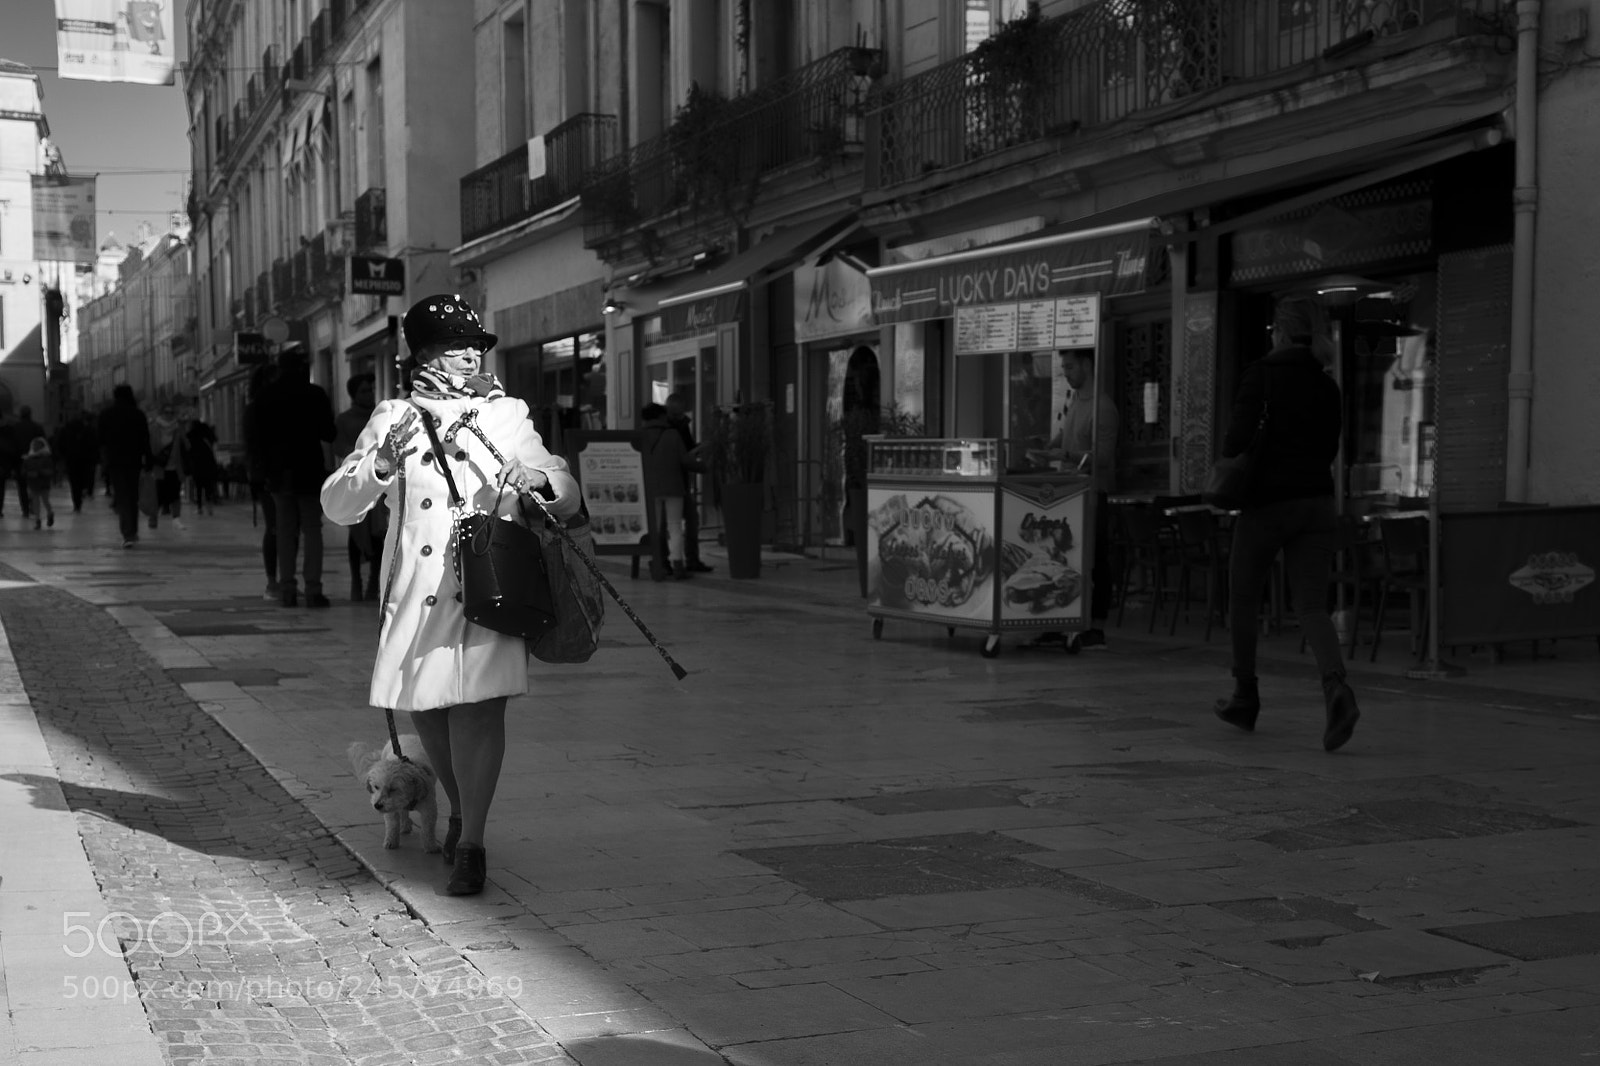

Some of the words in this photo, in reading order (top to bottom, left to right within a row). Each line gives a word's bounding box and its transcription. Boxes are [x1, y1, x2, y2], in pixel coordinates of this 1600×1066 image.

[939, 270, 998, 305] LUCKY
[1003, 262, 1050, 298] DAYS
[899, 508, 956, 531] LUCKY
